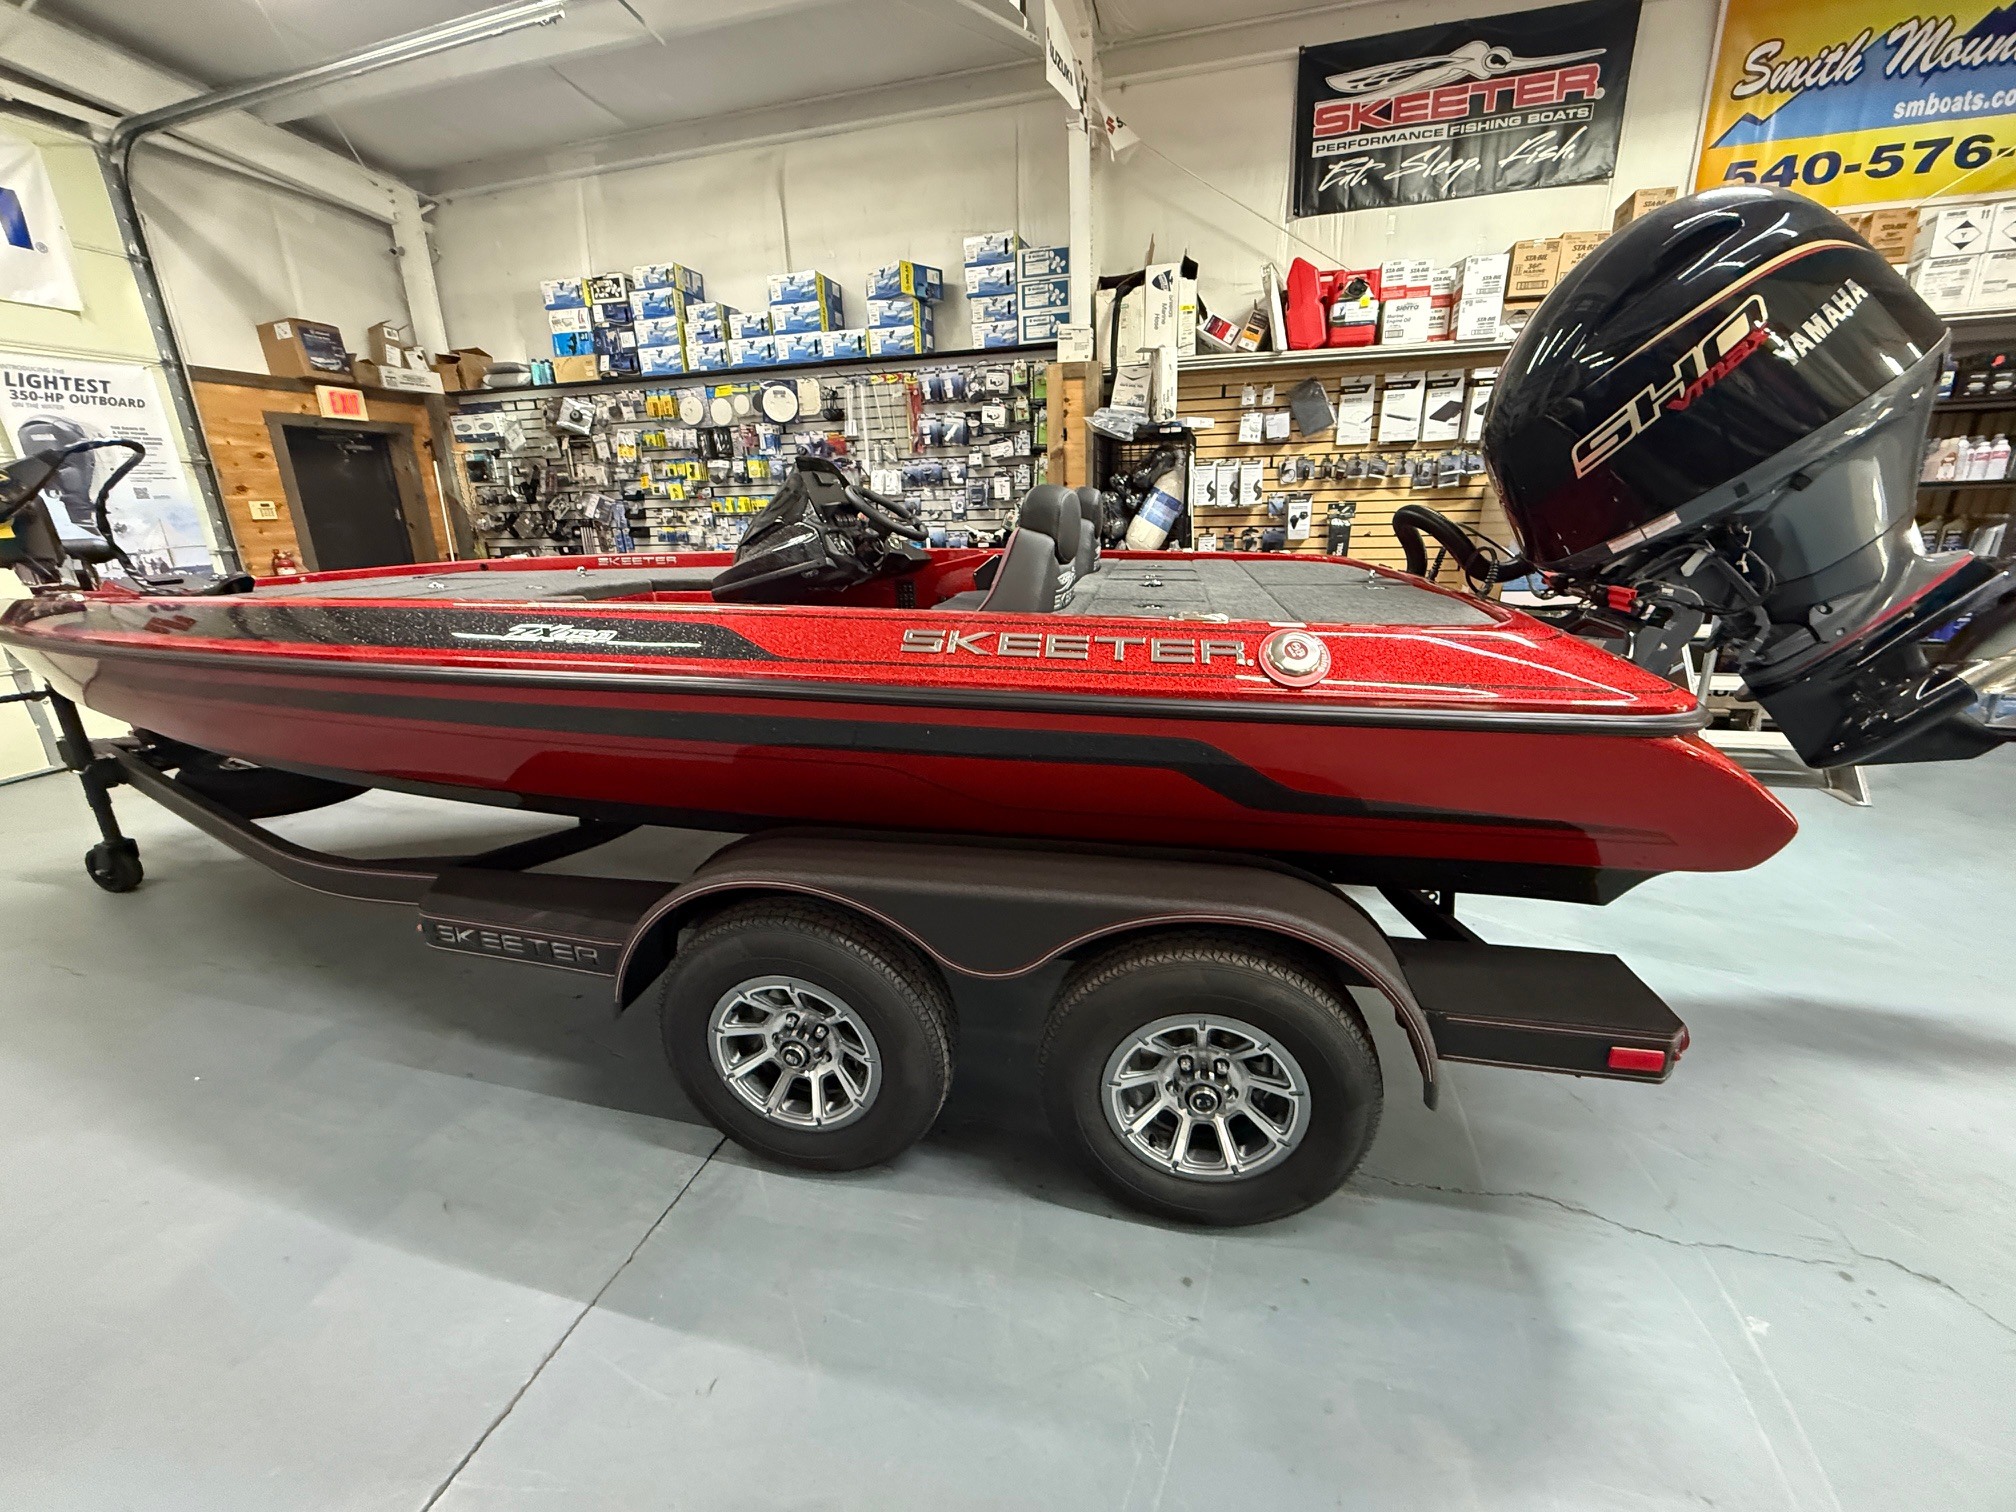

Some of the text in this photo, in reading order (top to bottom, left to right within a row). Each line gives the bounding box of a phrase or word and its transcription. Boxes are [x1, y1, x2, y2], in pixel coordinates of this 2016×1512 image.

[1732, 27, 1873, 100] Smith
[1313, 64, 1601, 138] SKEETER
[1893, 90, 2016, 120] smboats.co
[1316, 107, 1590, 153] PERFORMANCE FISHING BOATS
[1319, 125, 1588, 194] Eat. Sleep. Fish.
[1723, 135, 2016, 187] 540-576-
[1772, 278, 1869, 366] YAMAHA
[4, 371, 111, 394] LIGHTEST
[9, 389, 146, 408] 350-HP OUTBOARD
[328, 390, 361, 415] EXIT
[1571, 294, 1769, 479] SHO
[597, 556, 677, 566] SKEETER
[900, 628, 1247, 666] SKEETER
[435, 923, 601, 965] SKEETER
